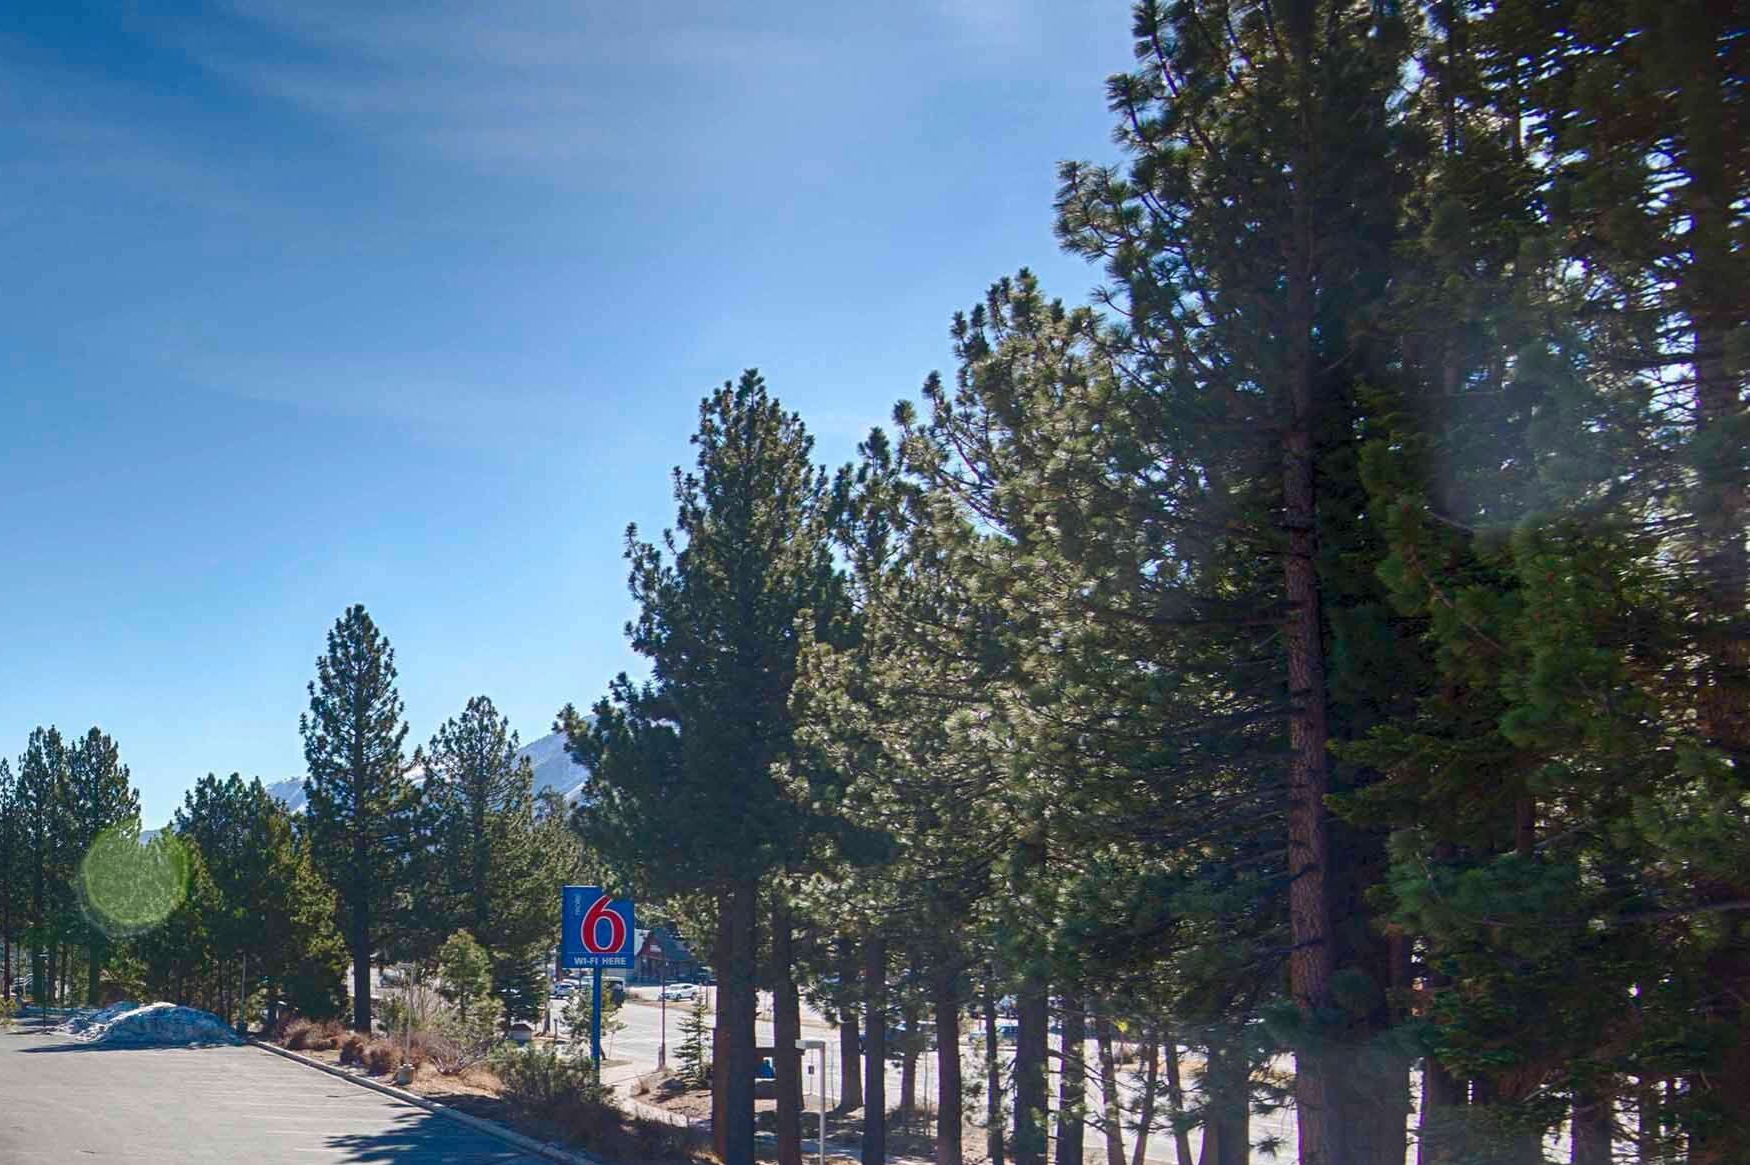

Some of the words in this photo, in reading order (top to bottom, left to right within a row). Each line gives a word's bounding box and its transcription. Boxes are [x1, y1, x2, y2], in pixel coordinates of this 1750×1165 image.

[581, 895, 626, 953] 6
[573, 957, 598, 965] WI-FI
[602, 957, 627, 965] HERE
